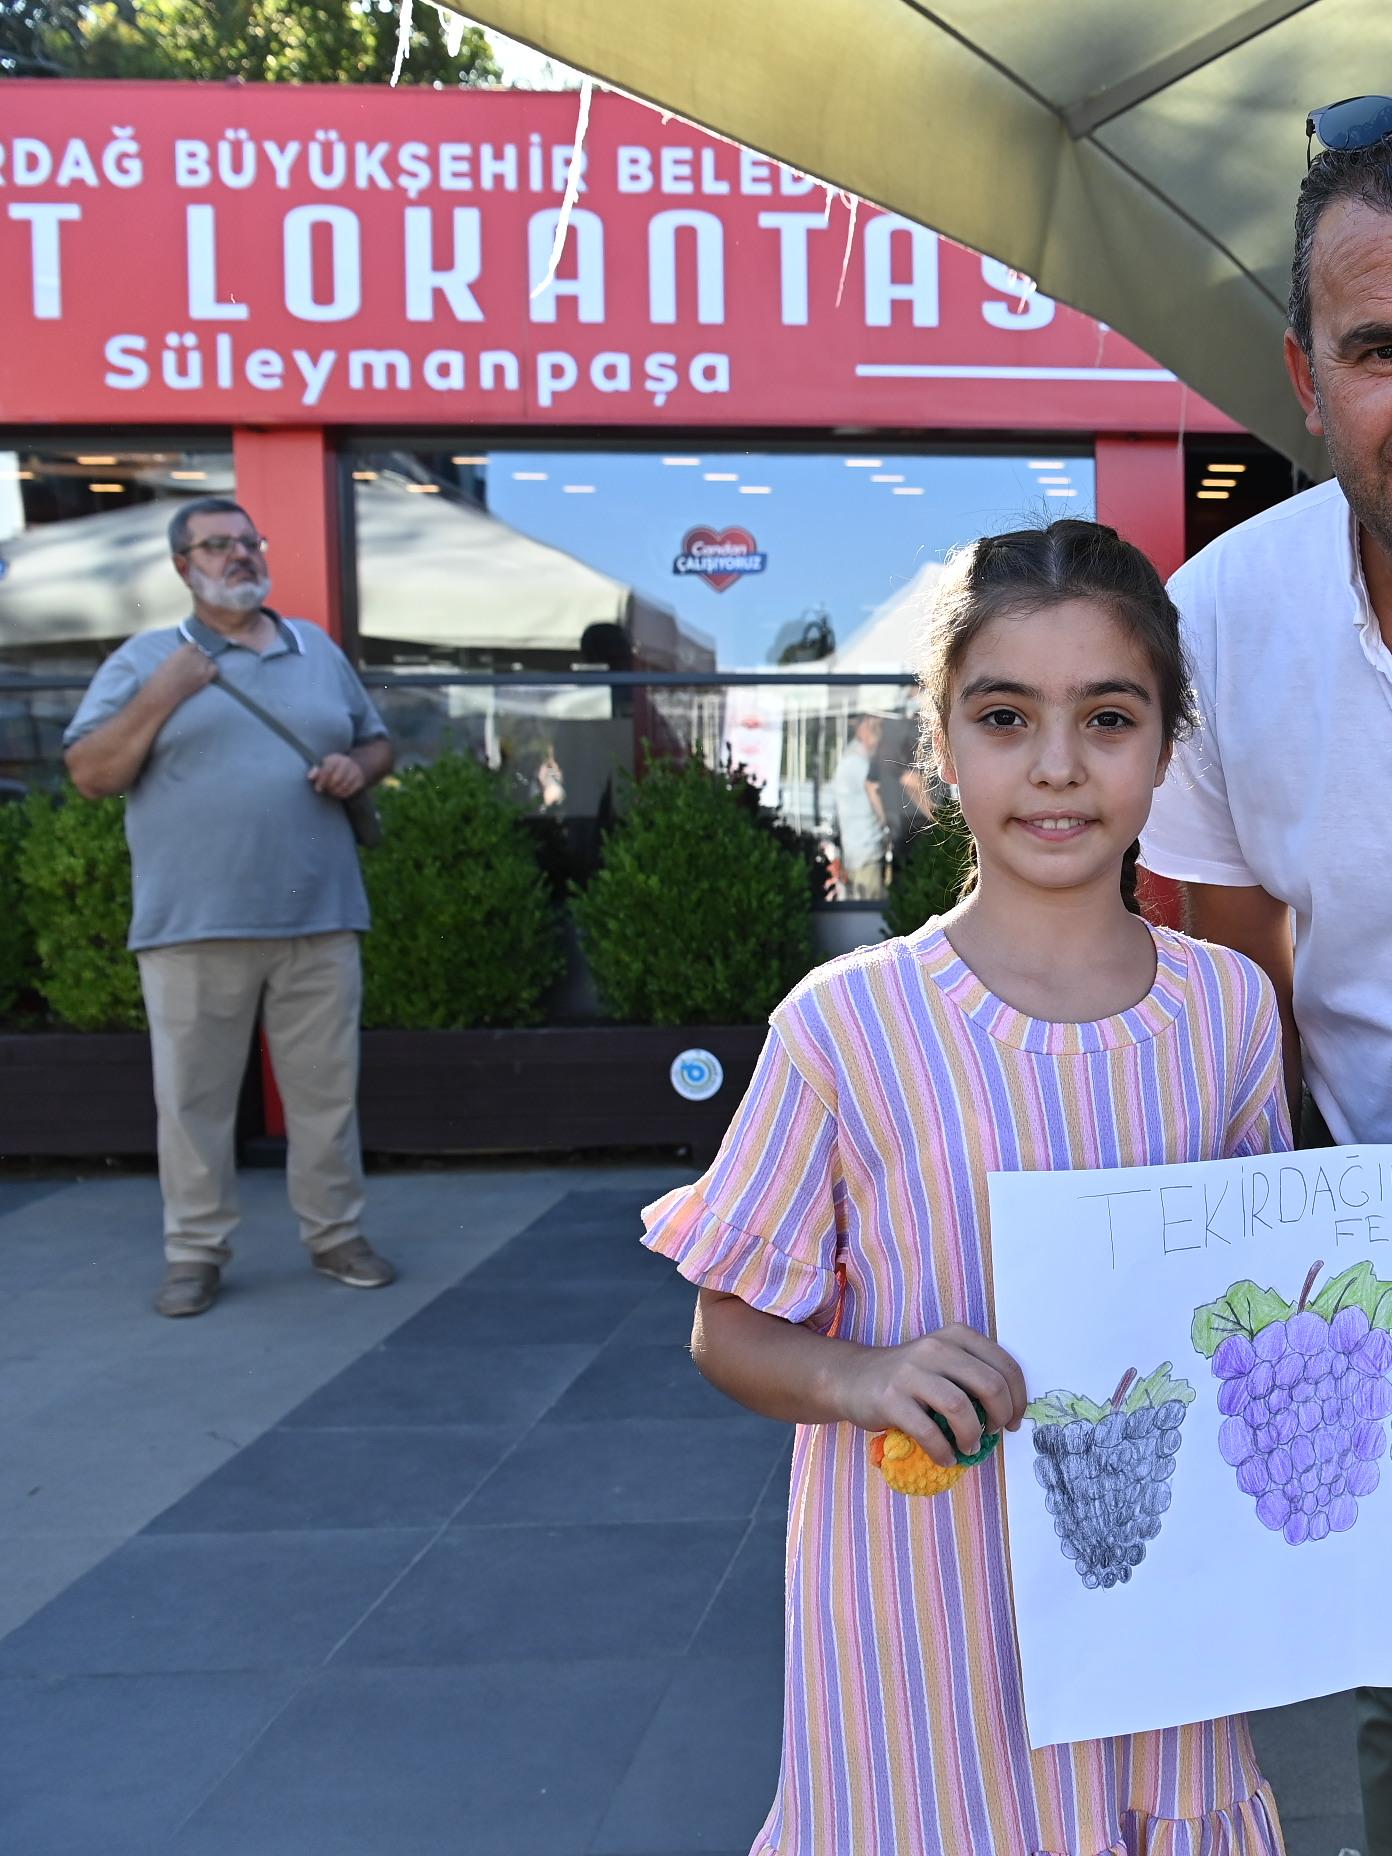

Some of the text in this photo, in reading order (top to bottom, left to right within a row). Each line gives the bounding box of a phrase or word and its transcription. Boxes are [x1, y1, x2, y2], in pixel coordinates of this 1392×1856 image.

[0, 126, 842, 199] DAĞ BÜYÜKŞEHİR BELED
[187, 203, 1110, 331] LOKANTAS
[104, 332, 731, 408] Süleymanpaşa
